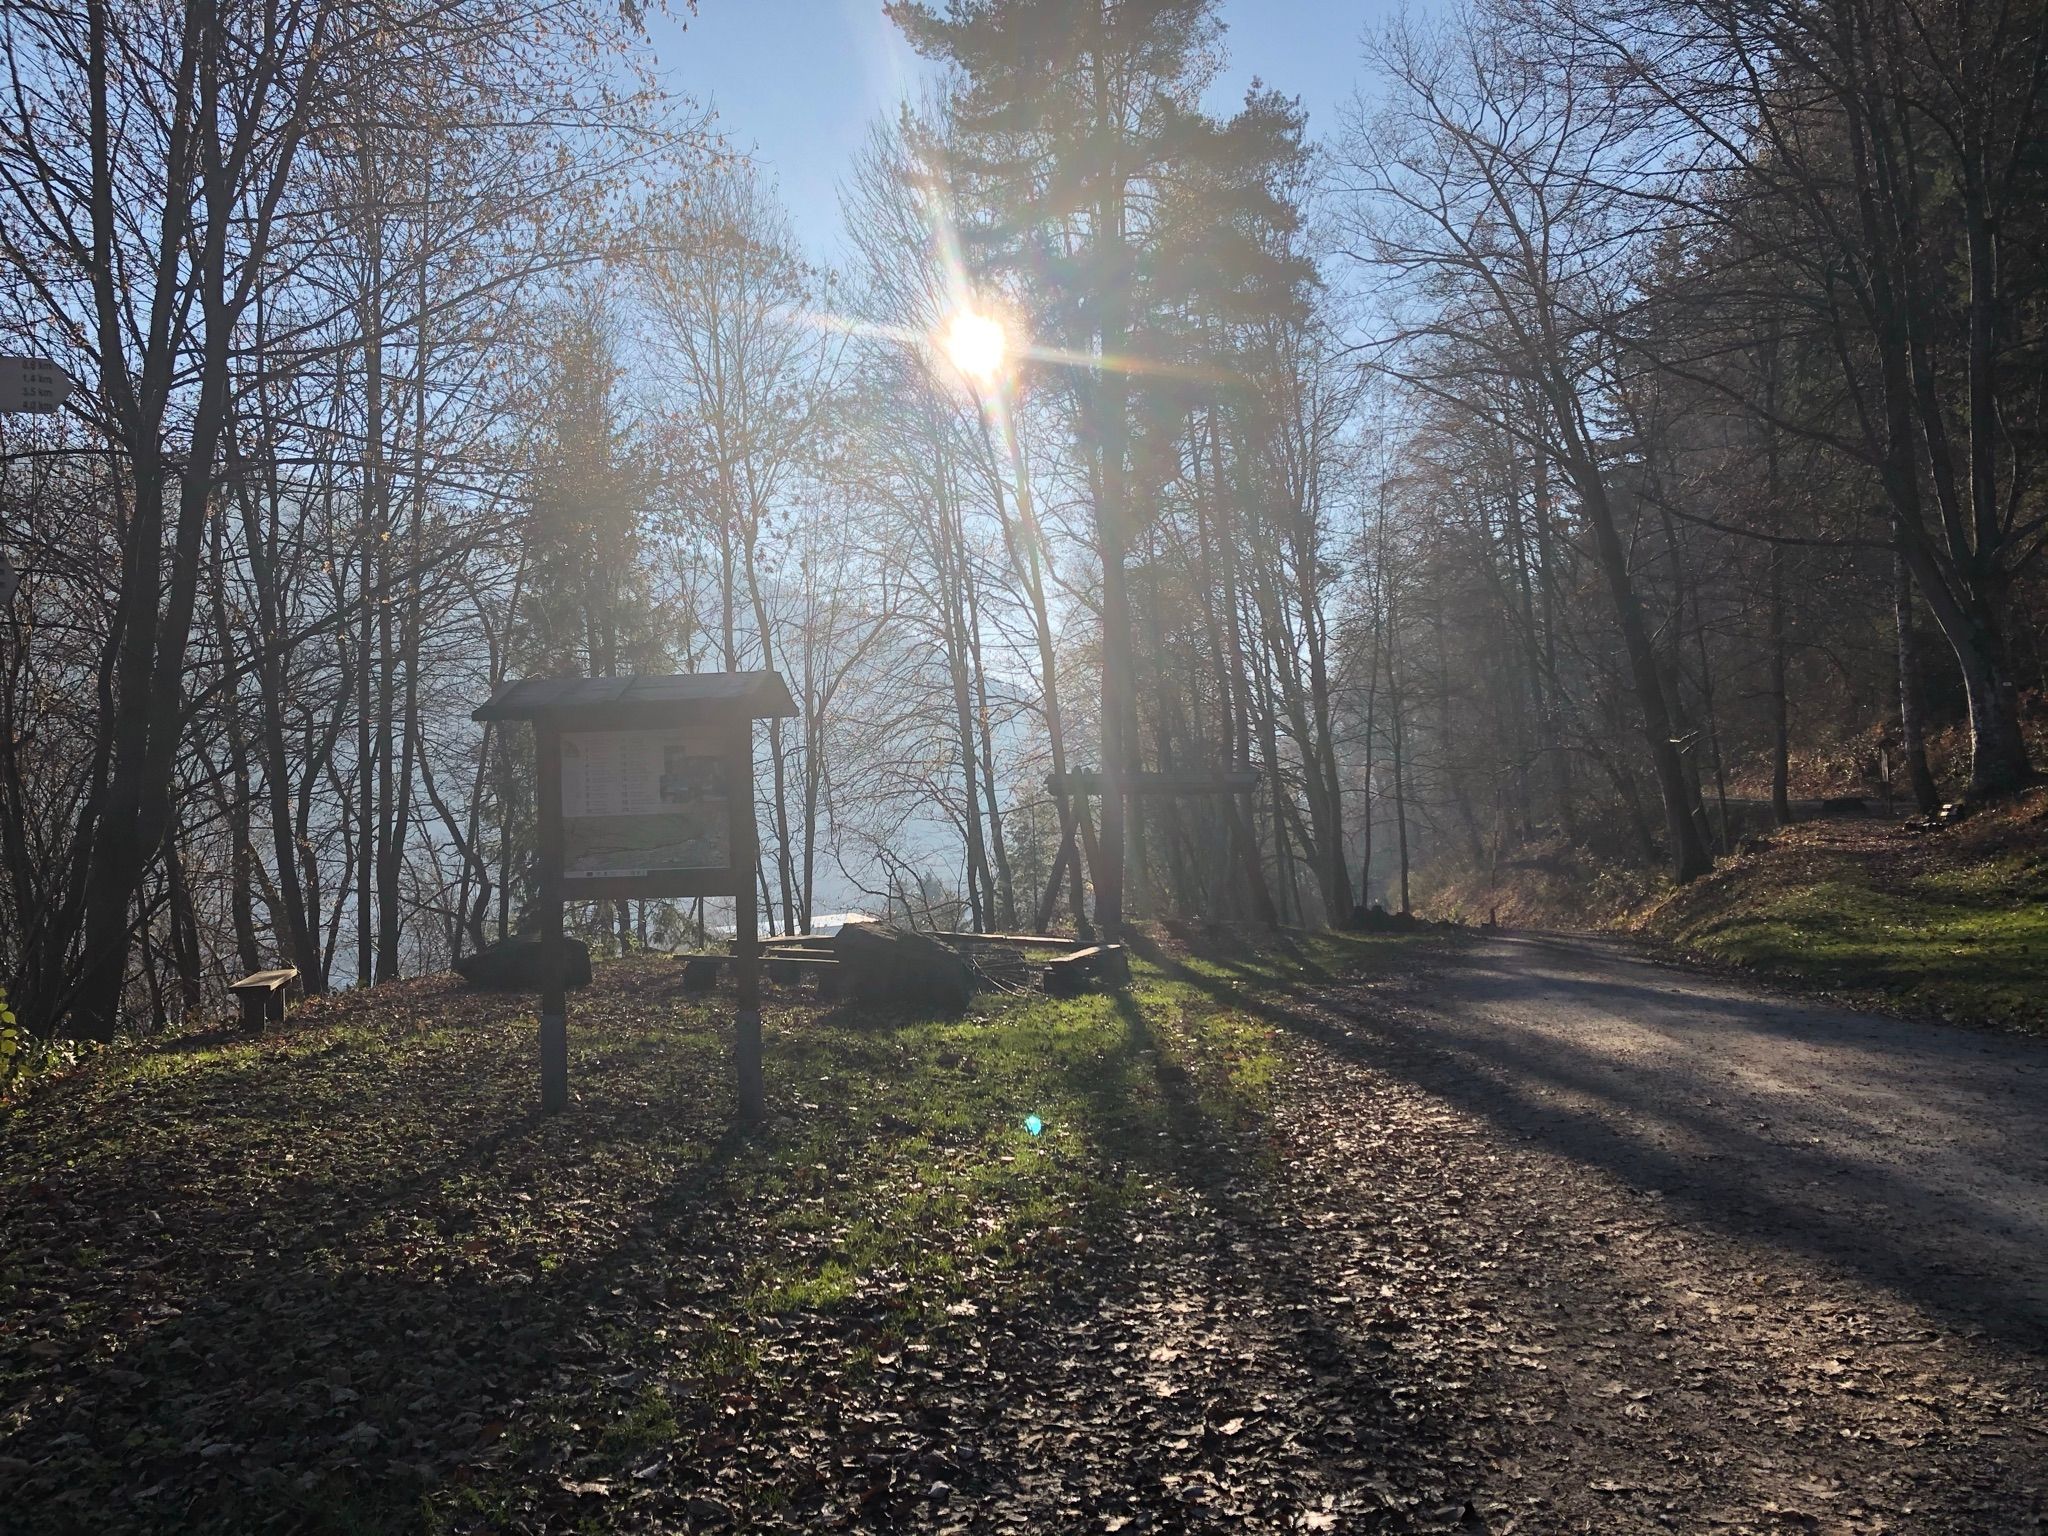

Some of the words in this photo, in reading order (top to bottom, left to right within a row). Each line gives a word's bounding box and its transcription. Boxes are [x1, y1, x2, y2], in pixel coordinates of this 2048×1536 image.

[38, 360, 53, 370] km
[38, 374, 53, 383] km
[38, 387, 53, 396] km
[38, 401, 53, 411] km
